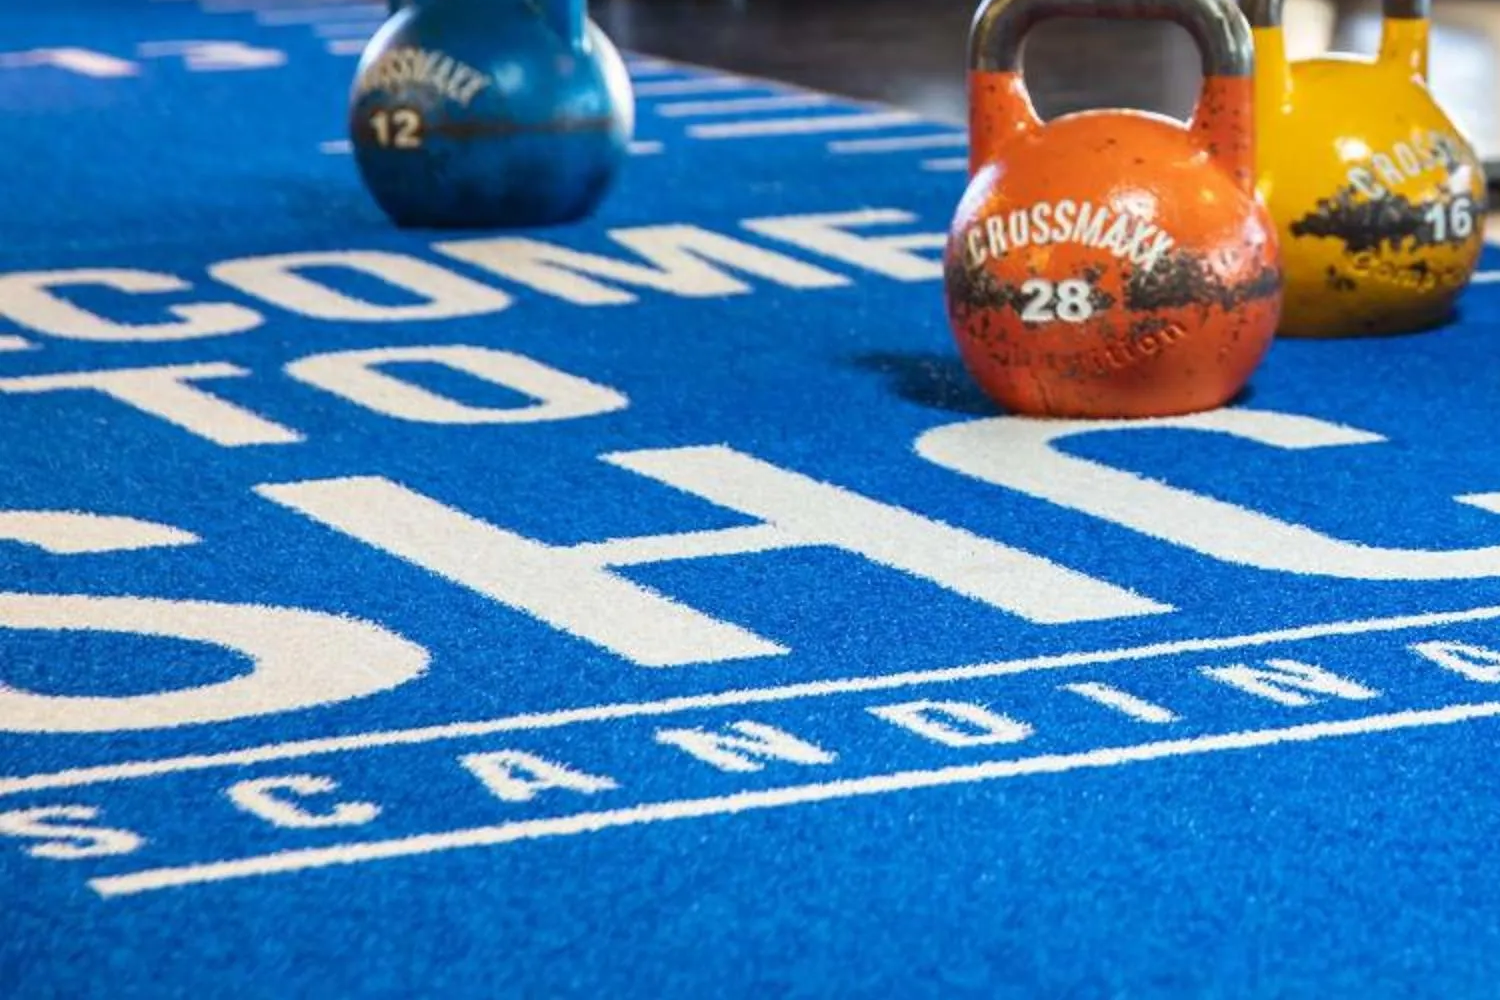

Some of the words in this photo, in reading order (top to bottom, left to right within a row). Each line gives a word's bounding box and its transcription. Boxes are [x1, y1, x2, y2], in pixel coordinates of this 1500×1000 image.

[369, 108, 421, 148] 12
[966, 199, 1176, 273] CROSSMAXX
[1424, 197, 1473, 241] 16
[0, 208, 947, 350] COME
[1020, 278, 1094, 323] 28
[0, 344, 629, 447] TO
